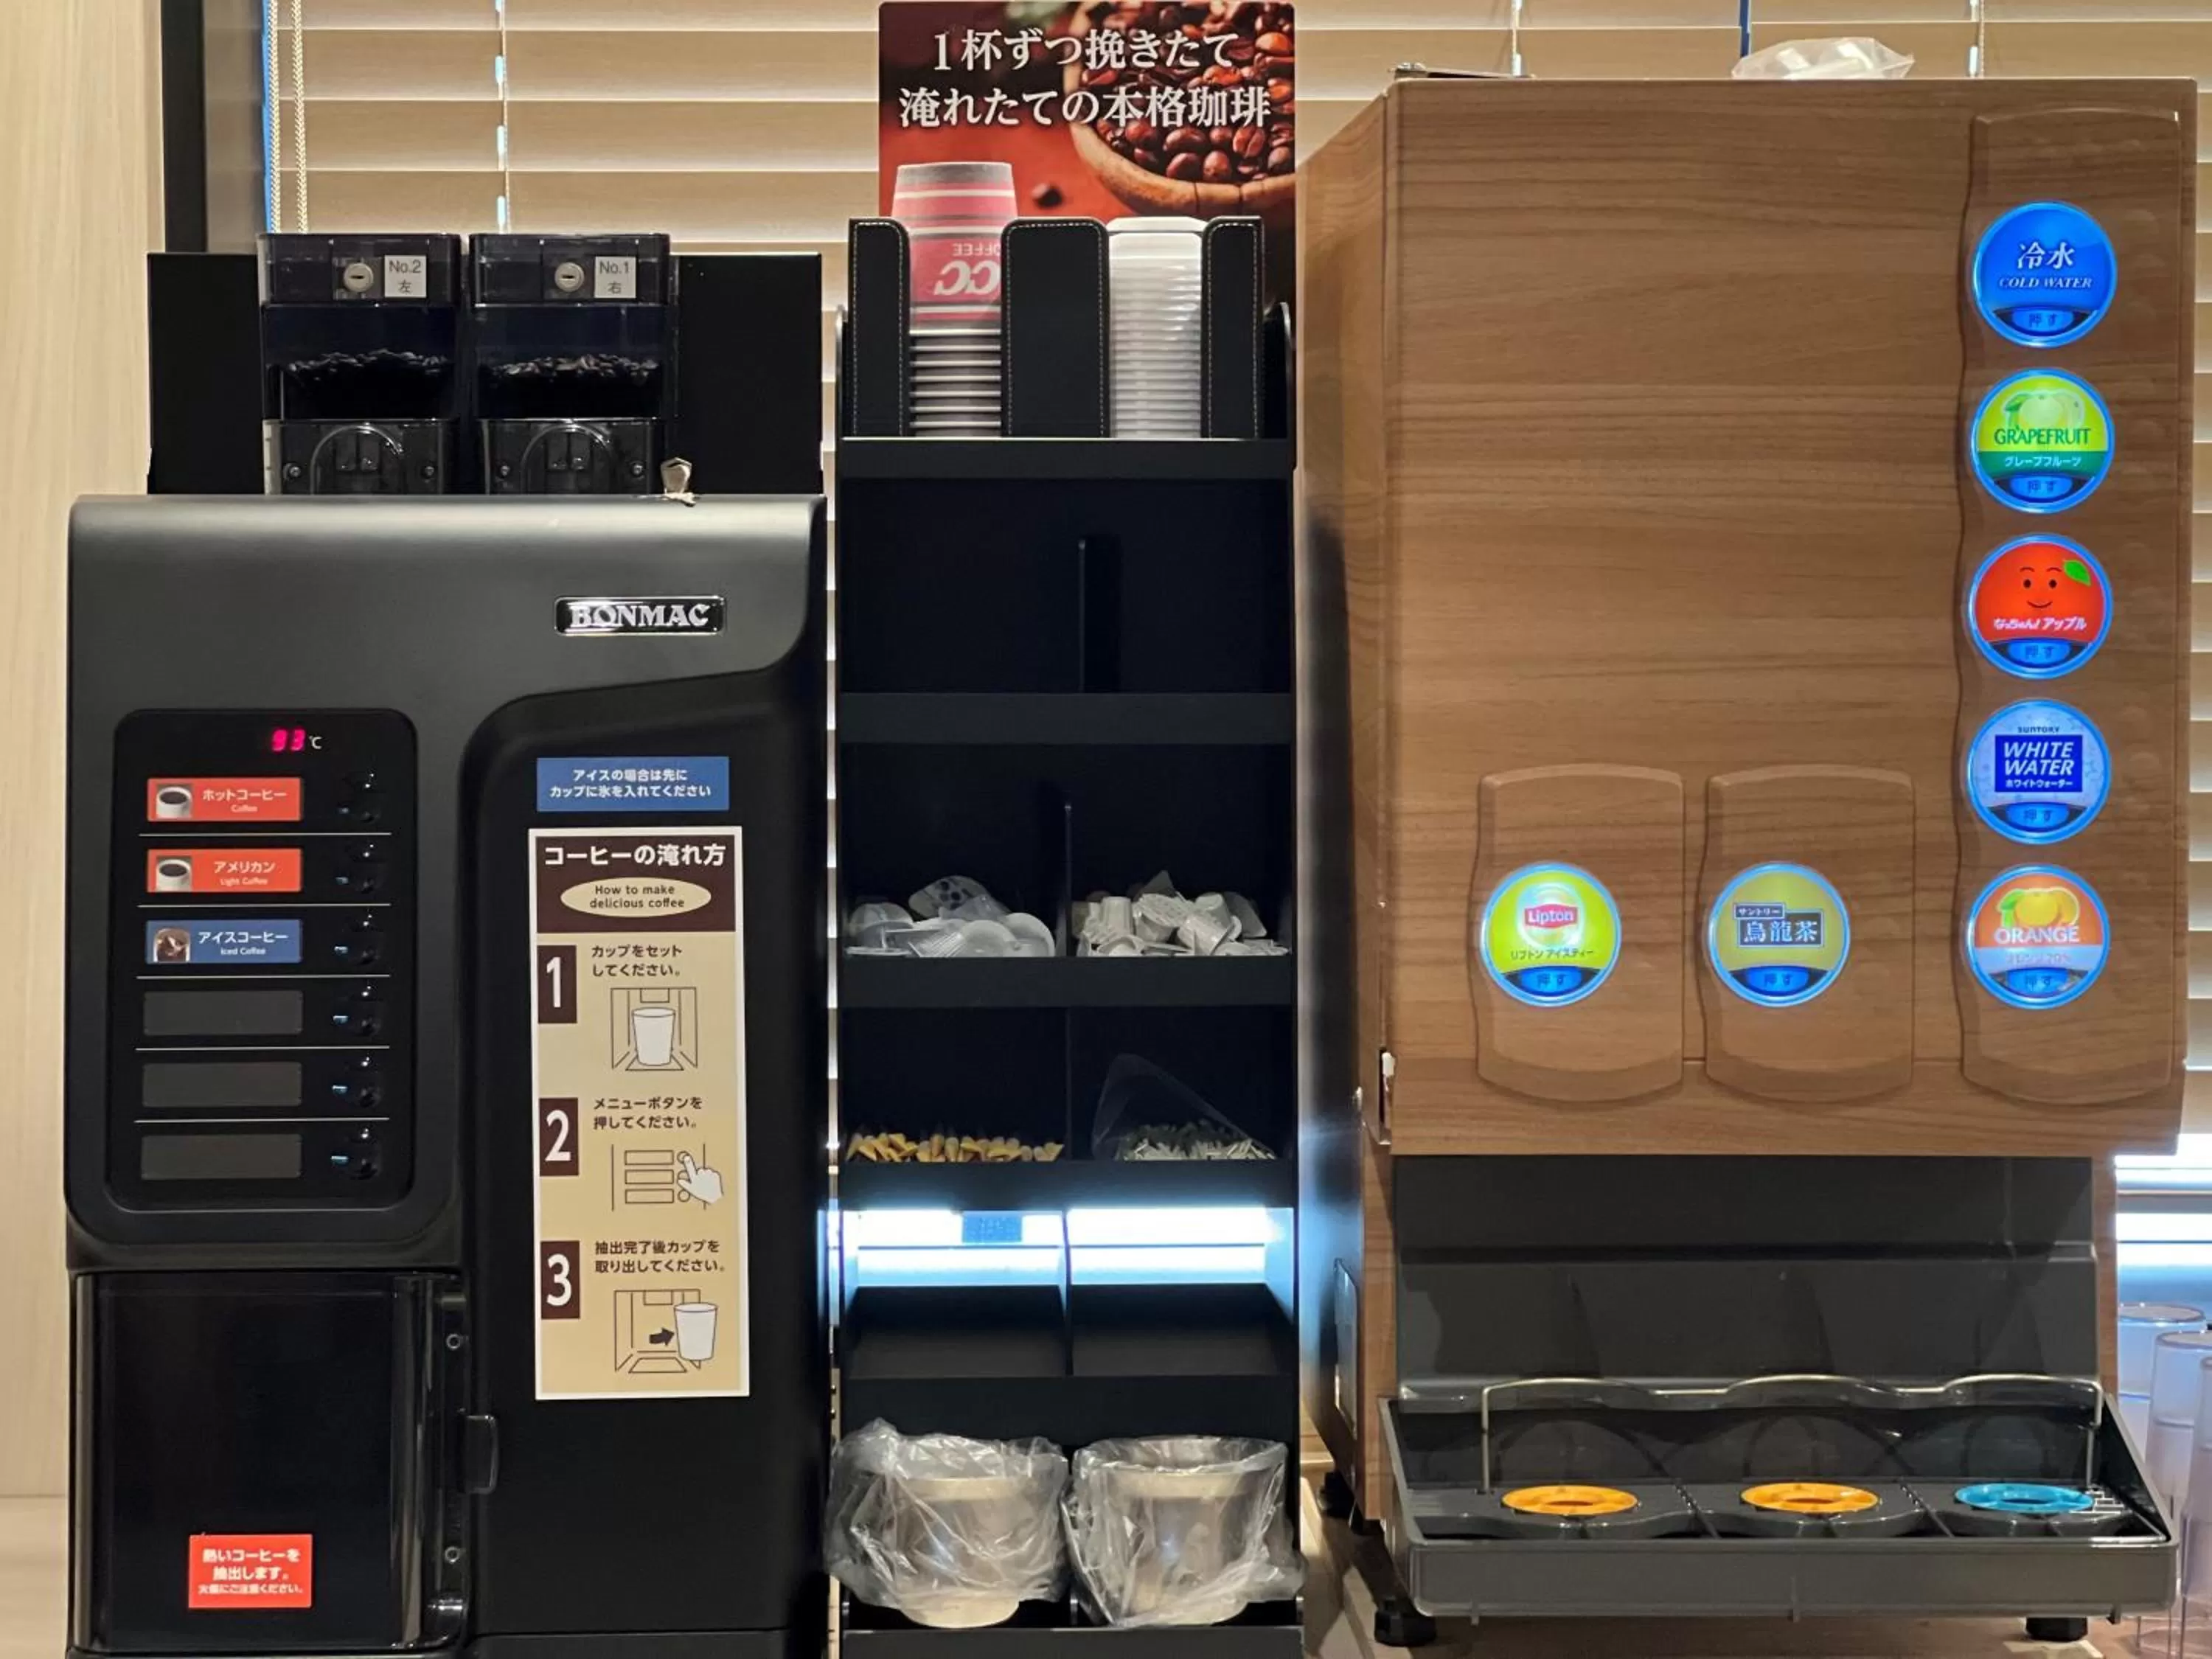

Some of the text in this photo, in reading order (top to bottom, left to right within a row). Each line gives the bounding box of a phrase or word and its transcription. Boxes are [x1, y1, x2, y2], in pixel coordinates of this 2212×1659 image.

[933, 27, 1239, 72] 1杯ずつ挽きたて
[899, 87, 1272, 128] 淹れたての本格珈琲
[953, 242, 1001, 257] OFFEE
[2017, 241, 2075, 269] 冷水
[389, 259, 422, 274] No.2
[599, 260, 630, 274] No.1
[933, 260, 1001, 296] CC
[1999, 277, 2093, 288] COLD WATER
[398, 279, 412, 294] 左
[607, 280, 622, 294] 右
[1994, 428, 2091, 445] GRAPEFRUIT
[2005, 456, 2081, 467] グレープフルーツ
[569, 603, 711, 627] BONMAC
[2004, 741, 2074, 758] WHITE
[2005, 759, 2075, 776] WATER
[573, 769, 688, 782] アイスの場合は先に
[202, 789, 288, 801] ホットコーヒー
[550, 785, 711, 799] カップに氷を入れてください
[545, 844, 726, 866] コーヒーの淹れ方
[214, 860, 276, 874] アメリカン
[595, 885, 675, 894] How to make
[589, 897, 685, 908] delicious coffee
[1528, 911, 1573, 924] Lipton
[198, 931, 288, 944] アイスコーヒー
[1744, 920, 1818, 942] 烏龍茶
[1994, 926, 2080, 944] ORANGE
[592, 945, 682, 958] カップをセット
[592, 964, 680, 977] してください。
[546, 956, 561, 1007] 1
[594, 1097, 703, 1110] メニューボタンを
[594, 1116, 696, 1130] 押してください。
[545, 1110, 571, 1161] 2
[595, 1240, 720, 1255] 抽出完了後カップを
[595, 1259, 725, 1273] 取り出してください。
[546, 1254, 571, 1306] 3
[203, 1548, 301, 1563] 熱いコーヒーを
